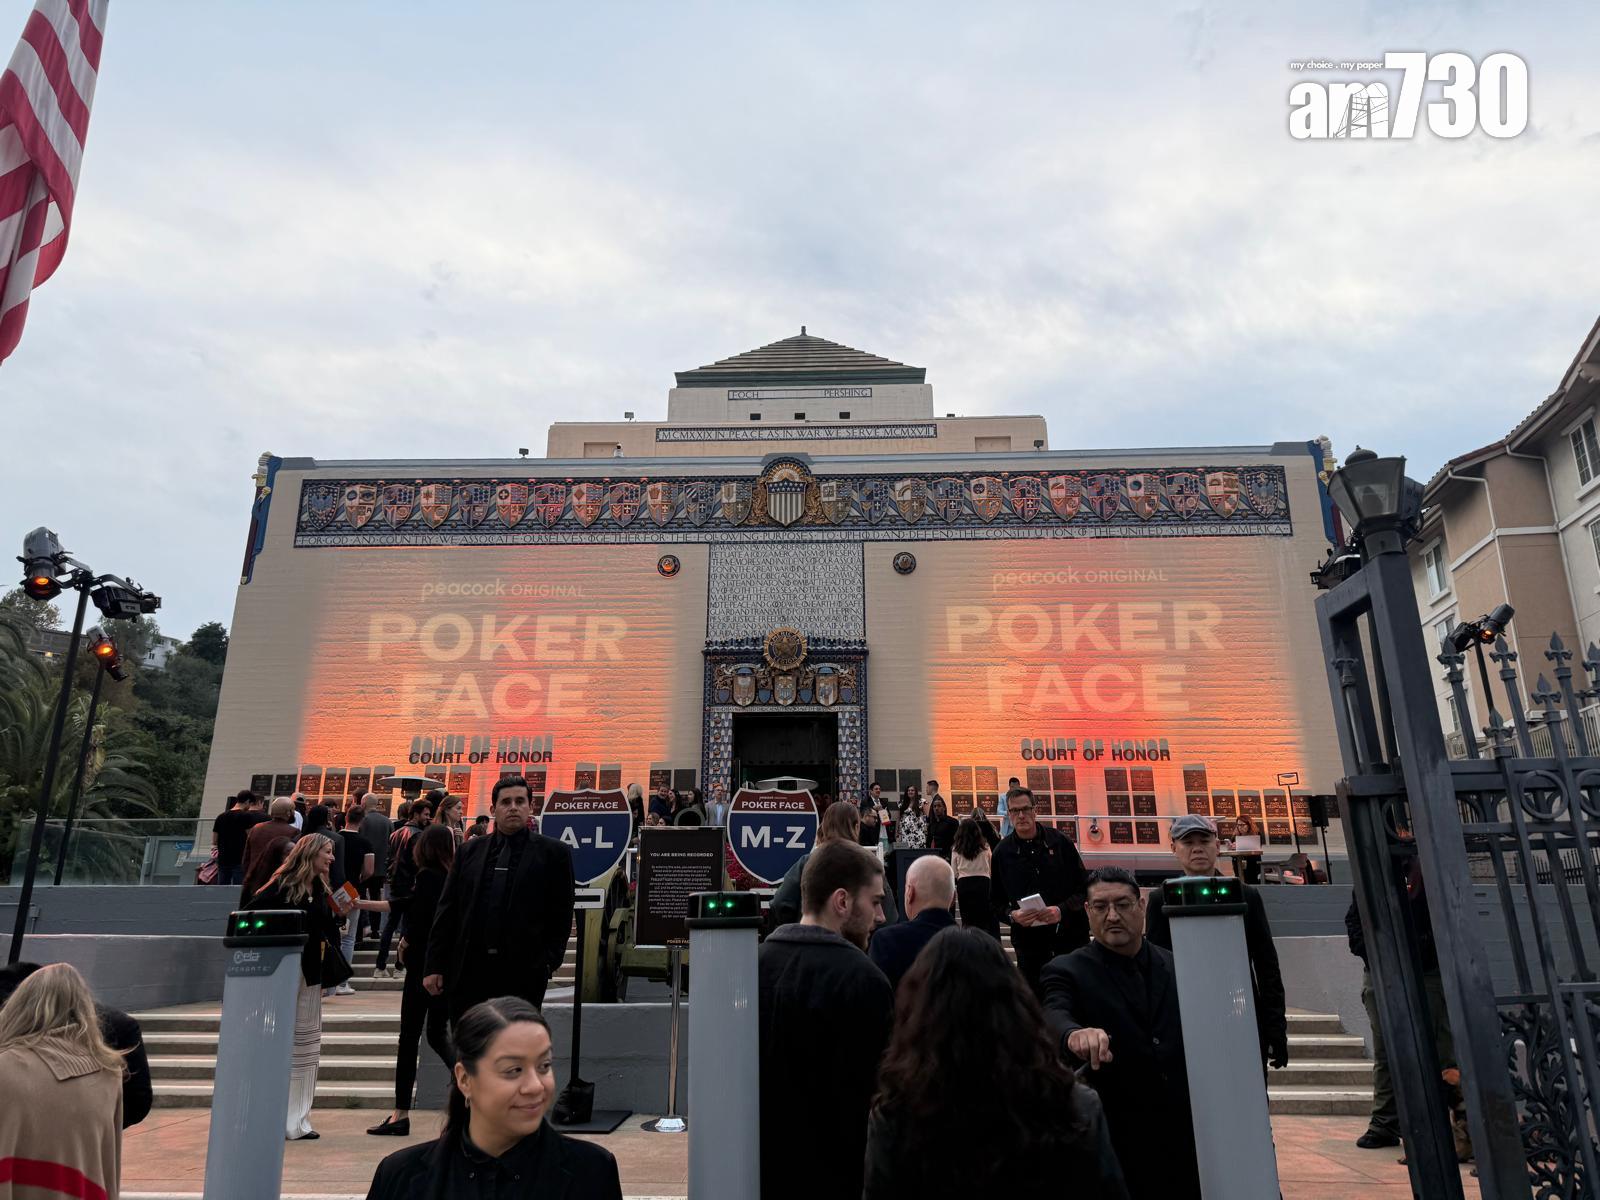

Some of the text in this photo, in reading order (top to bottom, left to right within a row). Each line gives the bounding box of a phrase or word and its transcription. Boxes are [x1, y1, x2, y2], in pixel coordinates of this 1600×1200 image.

[732, 391, 759, 399] FOCH
[824, 388, 868, 397] PERSHING
[662, 430, 712, 440] MCMXXIX
[728, 430, 763, 438] PEACE
[767, 430, 780, 438] AS
[796, 429, 820, 437] WAR
[846, 428, 880, 436] SERVE
[884, 428, 930, 436] MCMXVII
[300, 536, 322, 545] FOR
[325, 536, 349, 545] GOD
[352, 536, 376, 544] AND
[378, 534, 433, 544] COUNTRY
[643, 532, 666, 542] FOR
[671, 532, 692, 542] THE
[762, 530, 814, 540] PURPOSES
[820, 530, 838, 540] TO
[909, 530, 954, 539] DEFEND
[959, 529, 982, 538] THE
[1092, 528, 1117, 536] THE
[1120, 526, 1163, 536] UNITED
[1208, 526, 1226, 534] OF
[1228, 525, 1284, 534] AMERICA
[421, 578, 584, 602] peacock ORIGINAL
[992, 566, 1169, 593] peacock ORIGINAL
[367, 612, 628, 662] POKER
[945, 601, 1225, 654] POKER
[400, 672, 590, 719] FACE
[986, 663, 1190, 713] FACE
[409, 752, 552, 764] COURT OF HONOR
[1022, 748, 1170, 761] COURT OF HONOR
[560, 826, 614, 848] A-L
[741, 826, 806, 848] M-Z
